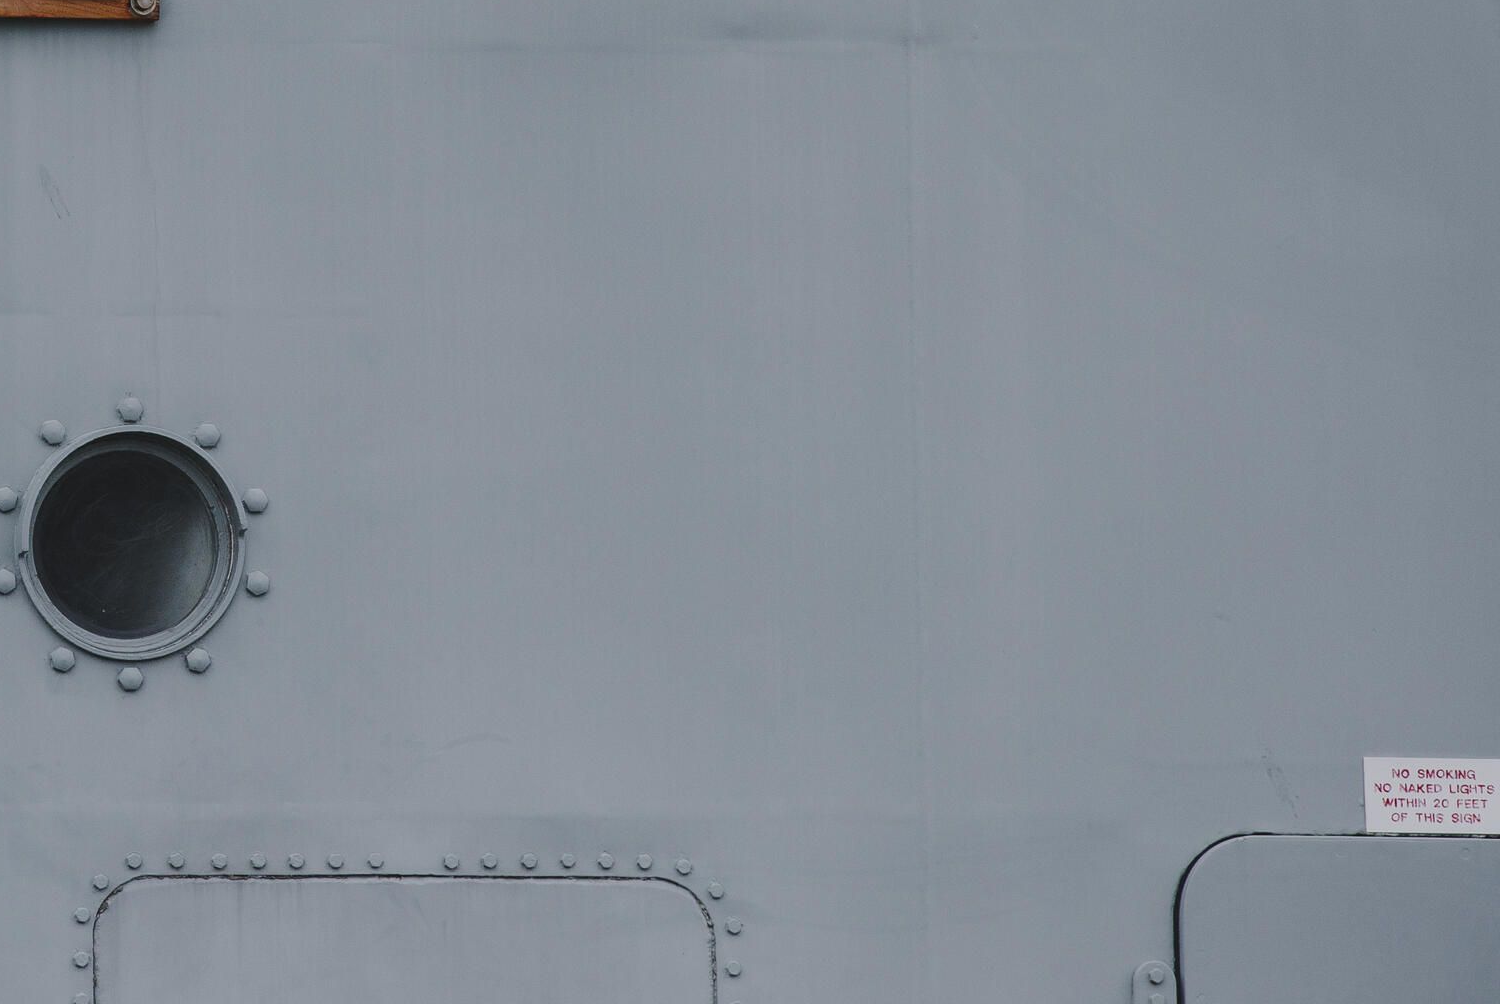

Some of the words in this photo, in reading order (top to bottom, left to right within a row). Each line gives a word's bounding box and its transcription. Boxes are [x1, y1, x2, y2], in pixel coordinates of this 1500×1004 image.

[1392, 768, 1410, 779] NO
[1417, 769, 1476, 780] SMOKING
[1374, 783, 1391, 793] NO
[1399, 783, 1442, 794] NAKED
[1449, 784, 1495, 795] LIGHTS
[1382, 797, 1426, 808] WITHIN
[1433, 798, 1449, 808] 20
[1456, 799, 1488, 809] FEET
[1391, 812, 1408, 822] OF
[1416, 812, 1443, 824] THIS
[1451, 812, 1481, 825] SIGN
